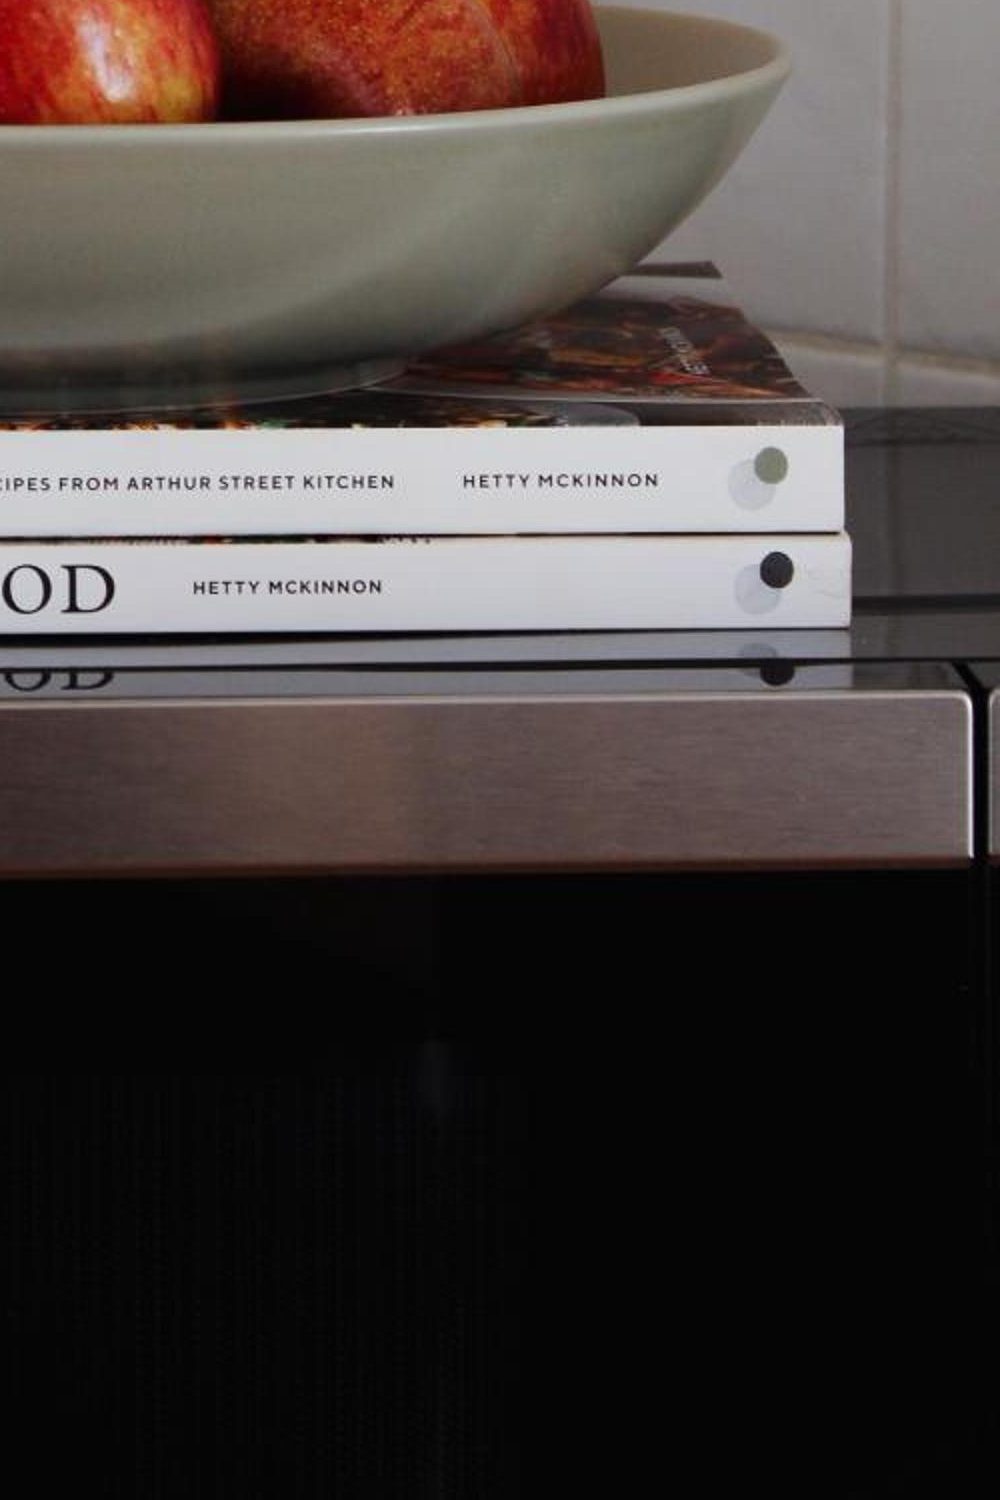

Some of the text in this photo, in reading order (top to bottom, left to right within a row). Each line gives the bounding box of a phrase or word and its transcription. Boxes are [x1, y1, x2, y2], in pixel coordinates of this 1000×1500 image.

[58, 477, 119, 492] FROM
[126, 475, 211, 492] ARTHUR
[218, 475, 295, 491] STREET
[303, 475, 394, 490] KITCHEN
[463, 473, 659, 489] HETTY MCKINNON
[193, 579, 382, 595] HETTY MCKINNON
